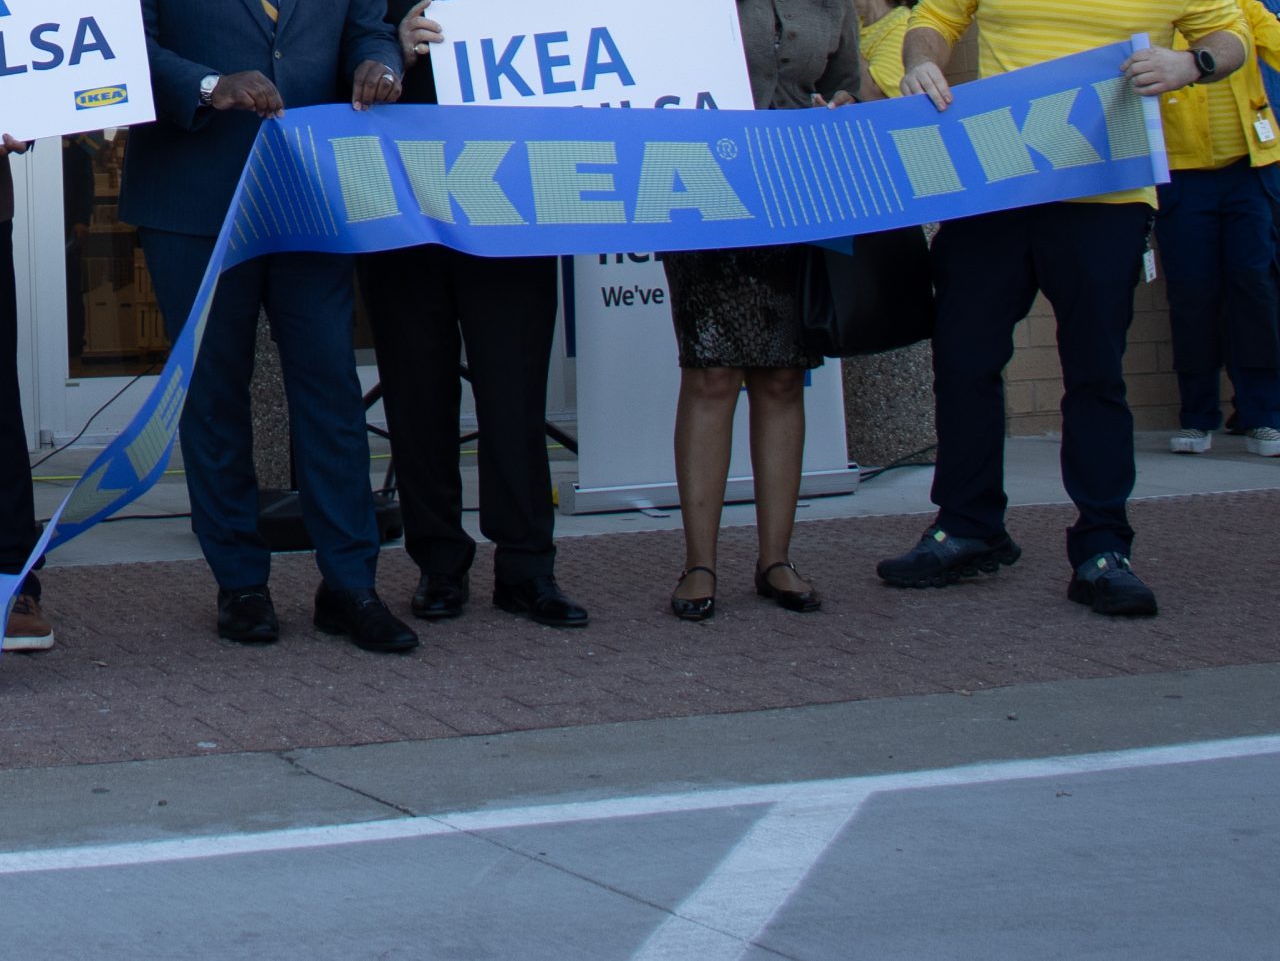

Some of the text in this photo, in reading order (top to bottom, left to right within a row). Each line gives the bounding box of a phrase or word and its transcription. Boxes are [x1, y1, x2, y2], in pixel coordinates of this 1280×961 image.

[453, 26, 636, 103] IKEA
[80, 90, 124, 104] IKEA
[601, 285, 665, 308] We've
